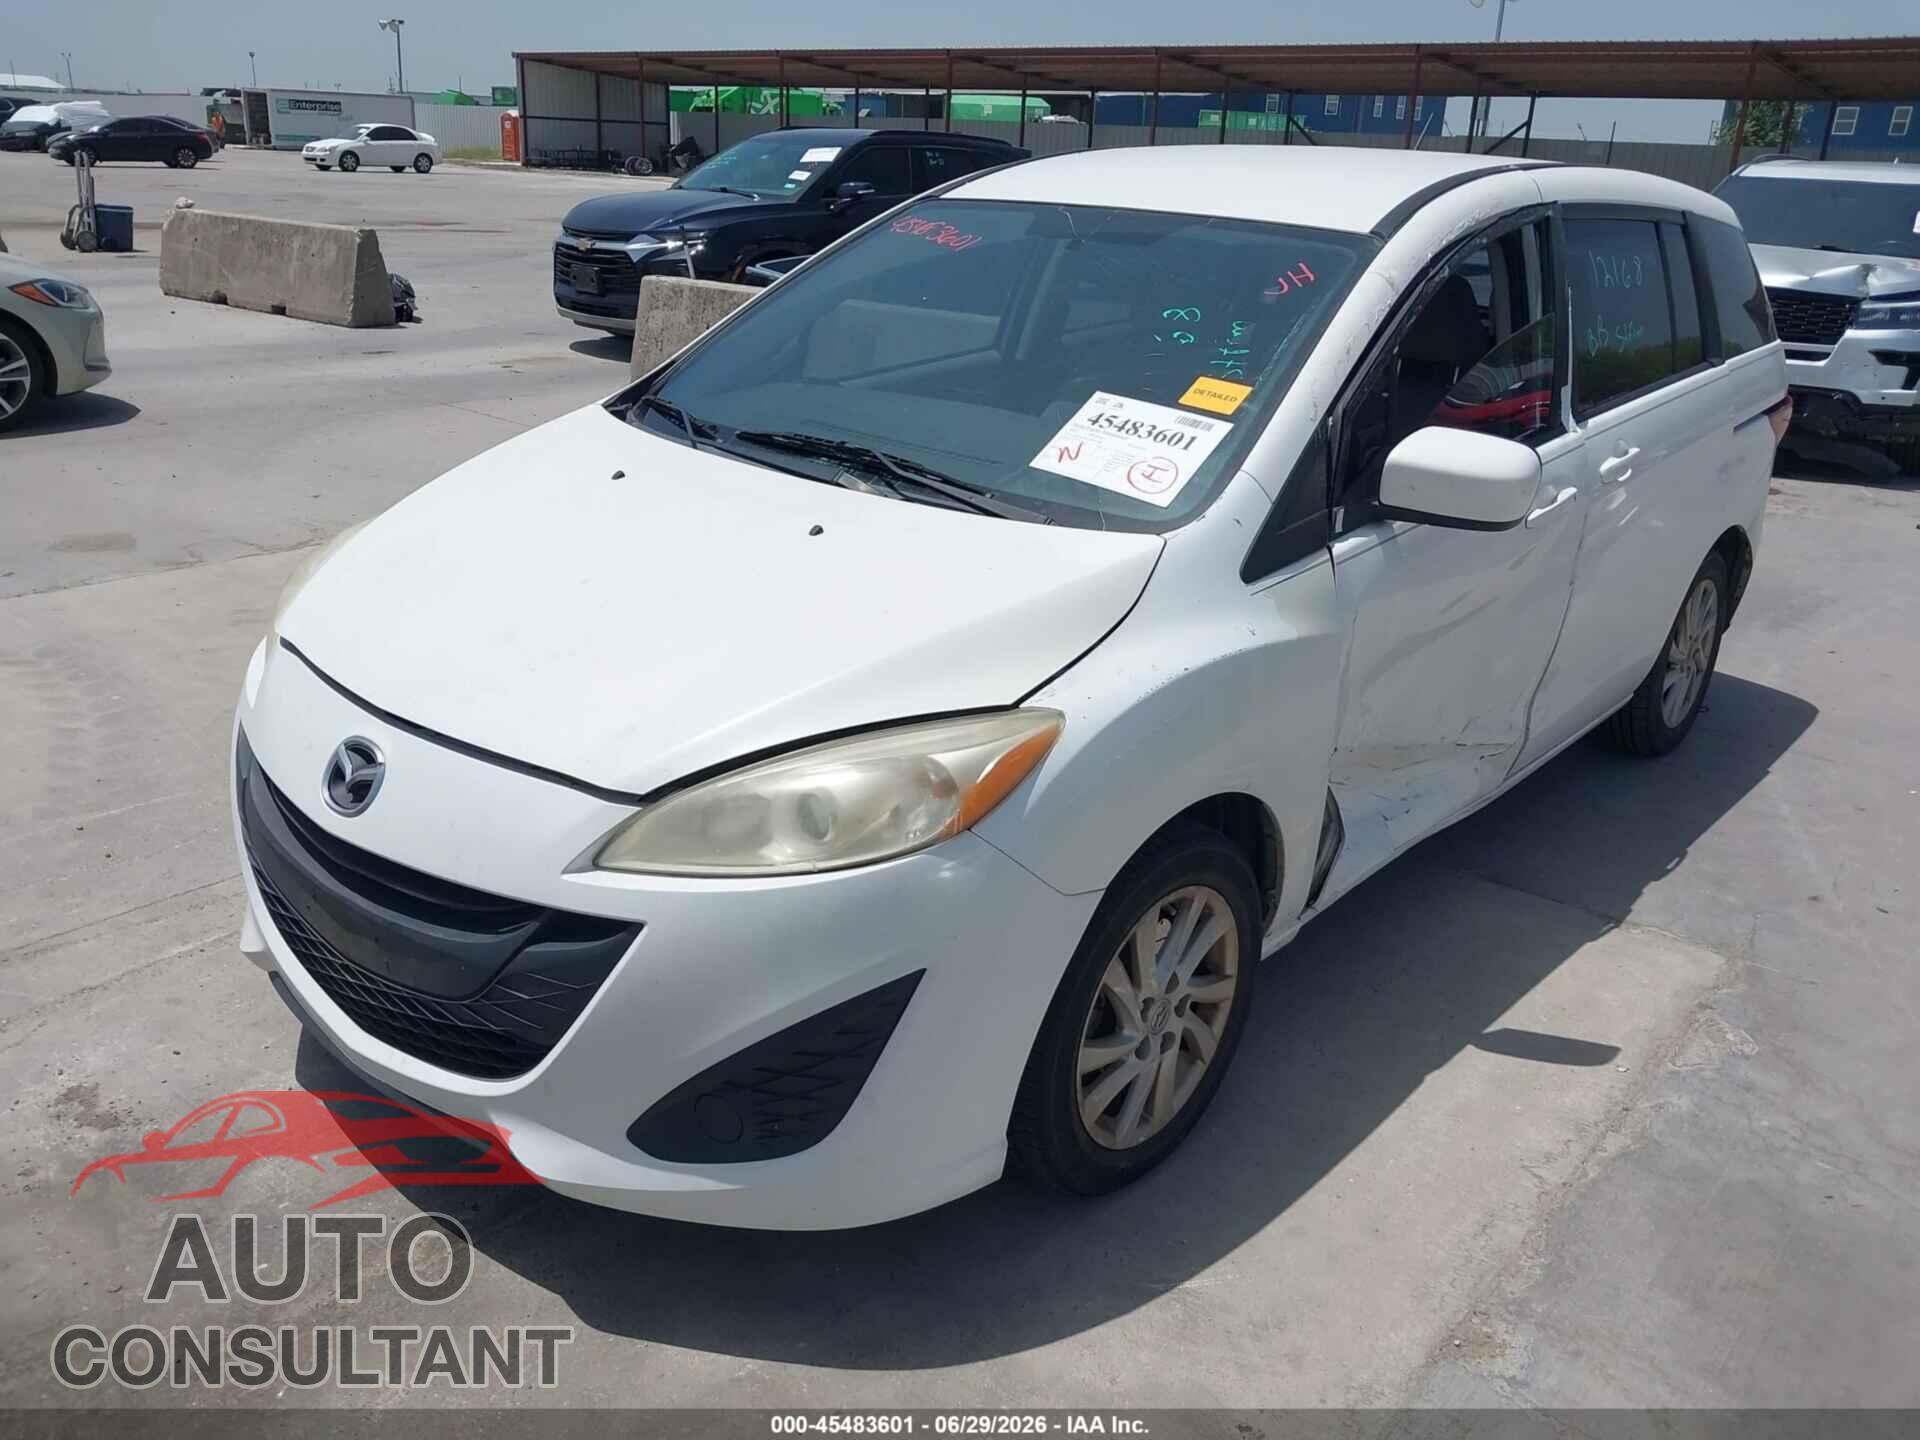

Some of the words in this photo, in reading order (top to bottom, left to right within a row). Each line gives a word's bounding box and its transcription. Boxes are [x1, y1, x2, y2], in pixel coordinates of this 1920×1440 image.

[290, 100, 341, 113] Enterprise
[1193, 387, 1238, 402] DETAILED
[1087, 411, 1198, 451] 45483601
